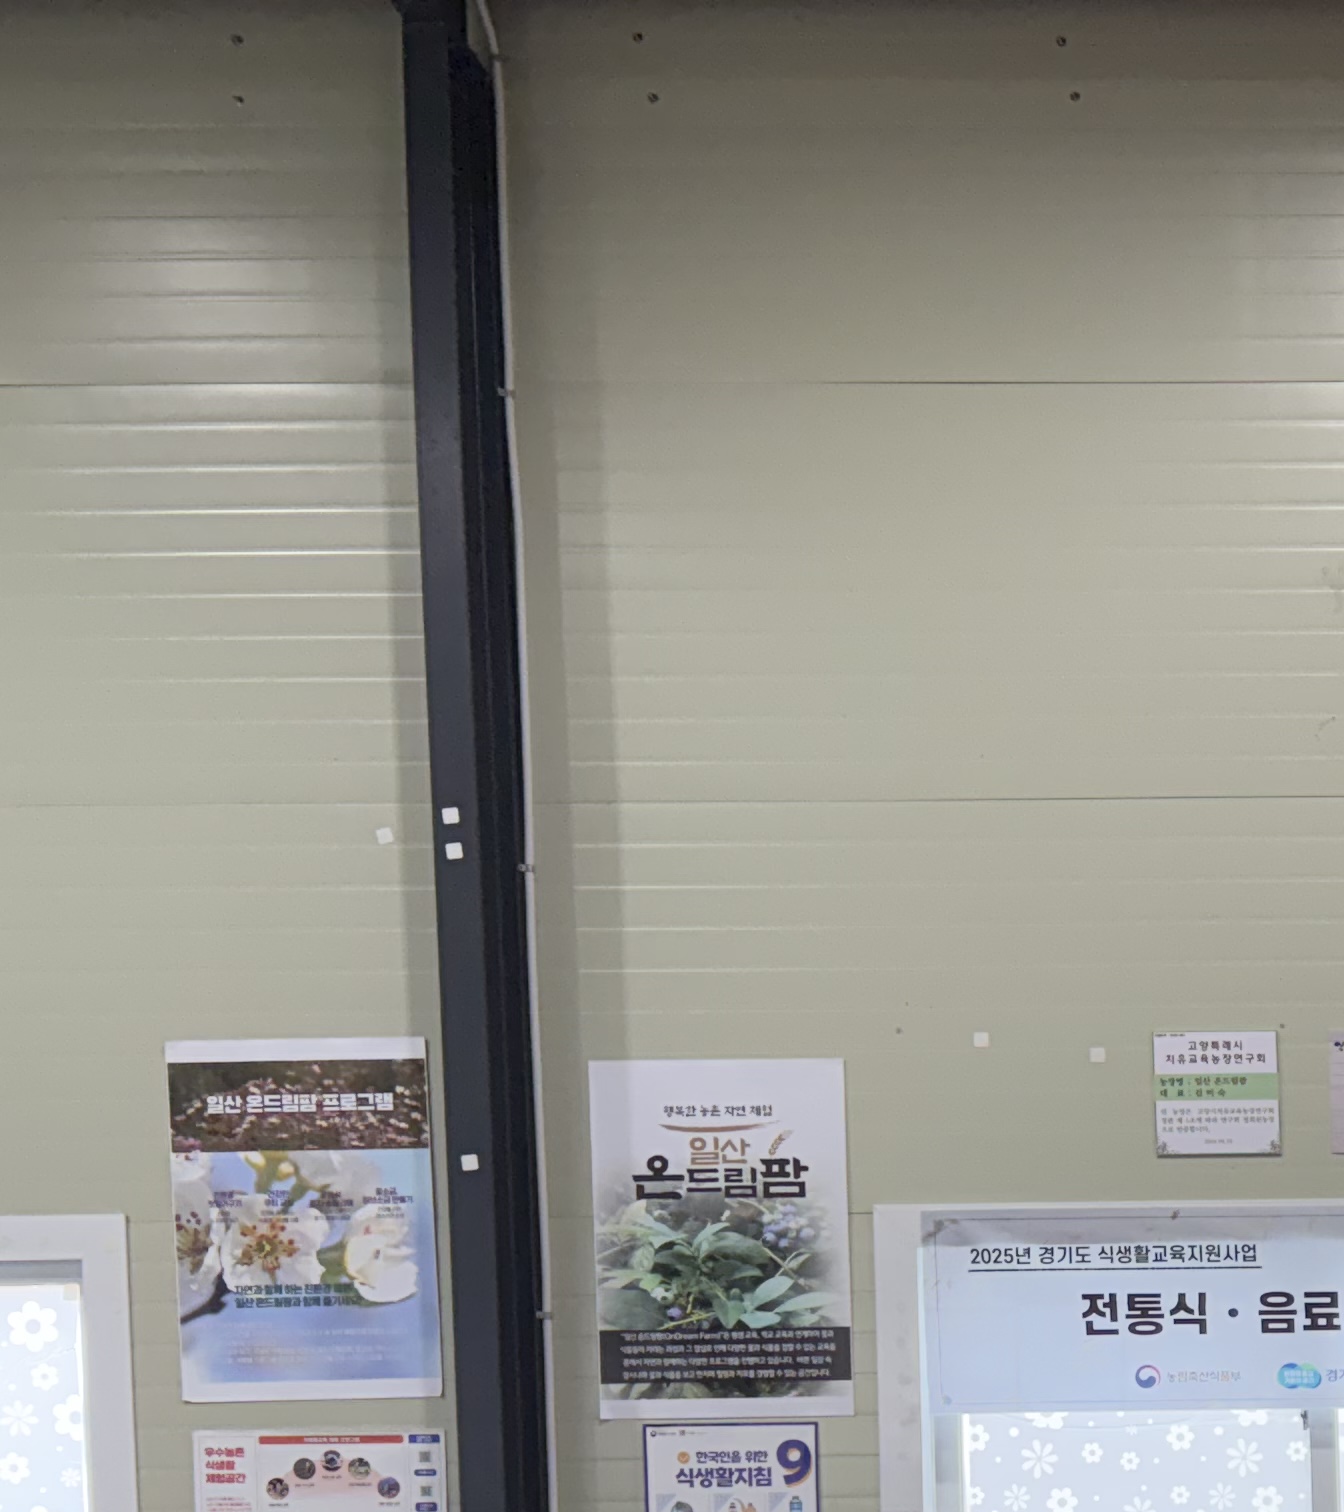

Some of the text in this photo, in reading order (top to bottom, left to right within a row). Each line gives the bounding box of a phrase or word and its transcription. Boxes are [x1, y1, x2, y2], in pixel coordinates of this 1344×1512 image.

[206, 1092, 394, 1114] 일산 온드림팜 프로그램
[664, 1104, 772, 1117] 행복한 농촌 자연 체험
[690, 1137, 750, 1166] 일산
[632, 1155, 809, 1200] 온드림팜
[970, 1244, 1258, 1264] 2025년 경기도 식생활교육지원사업
[235, 1285, 263, 1294] 자연과
[236, 1297, 254, 1308] 일산
[1082, 1292, 1207, 1336] 전통식
[1258, 1292, 1341, 1333] 음료
[1167, 1371, 1241, 1384] 농림축산식품부
[696, 1450, 768, 1463] 한국인을 위한
[776, 1439, 813, 1488] 9
[676, 1466, 772, 1488] 식생활지침
